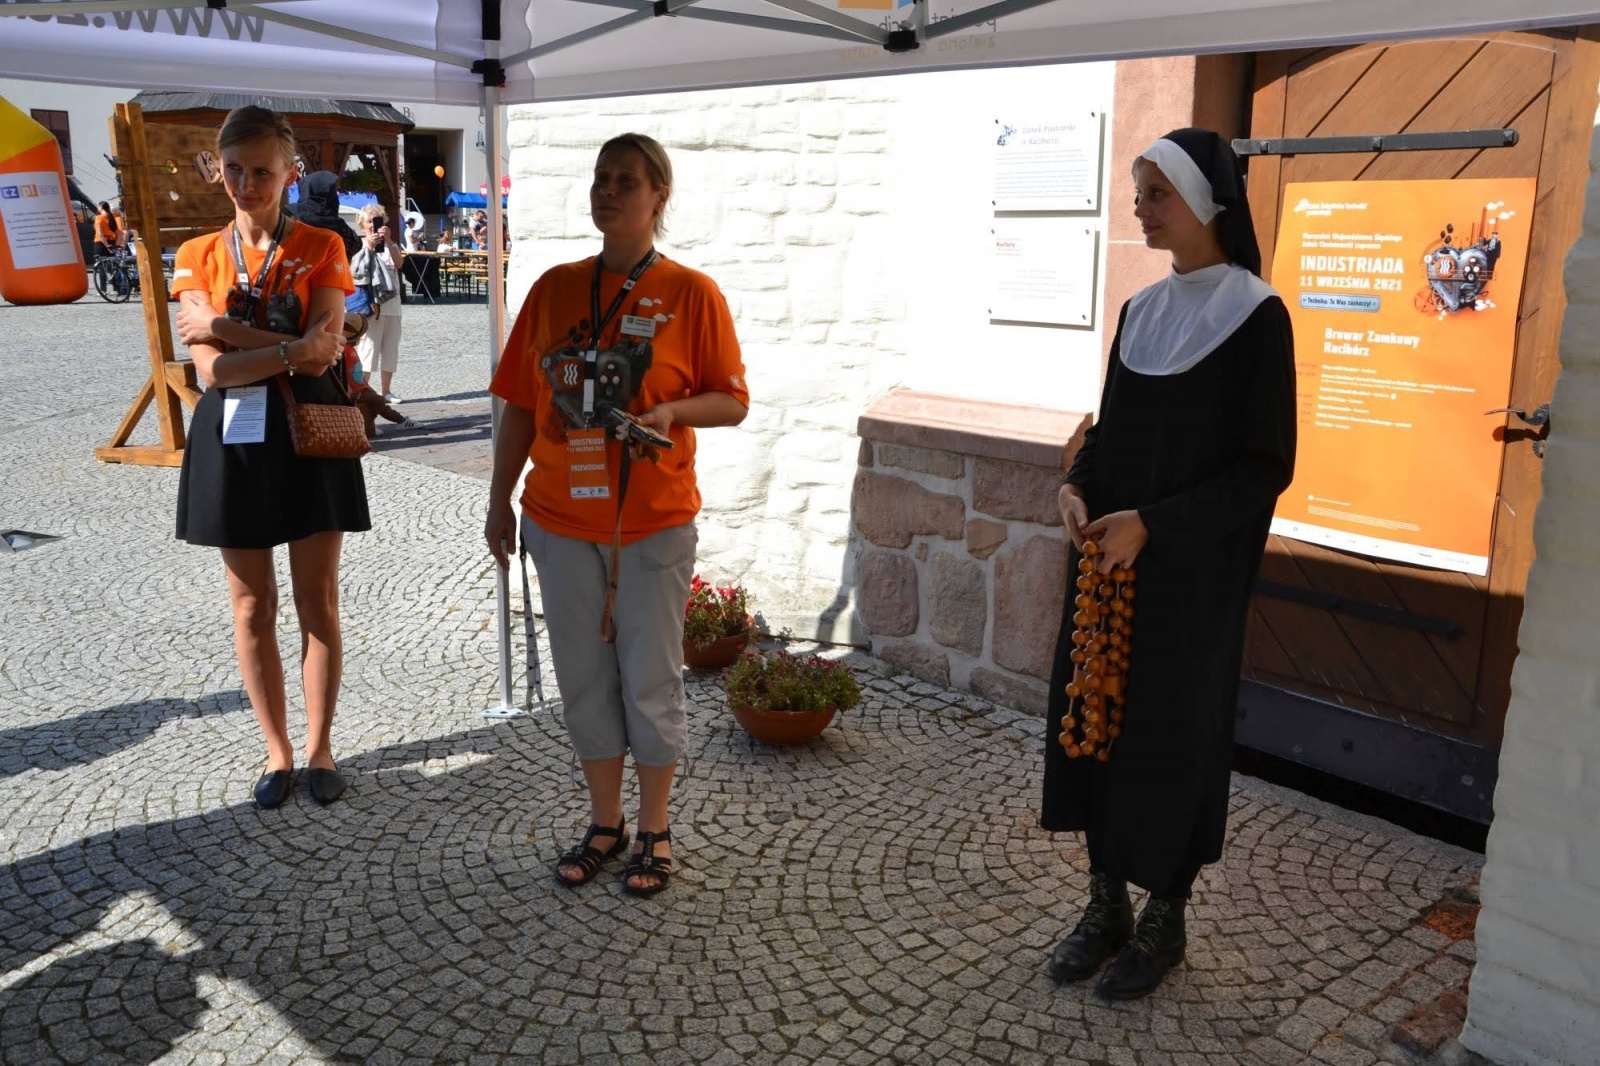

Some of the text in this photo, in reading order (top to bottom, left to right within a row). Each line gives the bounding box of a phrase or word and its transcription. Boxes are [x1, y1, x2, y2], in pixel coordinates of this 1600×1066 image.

[1301, 255, 1404, 273] INDUSTRIADA
[1299, 275, 1402, 291] 11 WRZEŚNIA 2021
[1325, 328, 1420, 349] Browar Zamkowy
[1323, 342, 1370, 357] Racibórz
[569, 437, 605, 446] INDUSTRIADA
